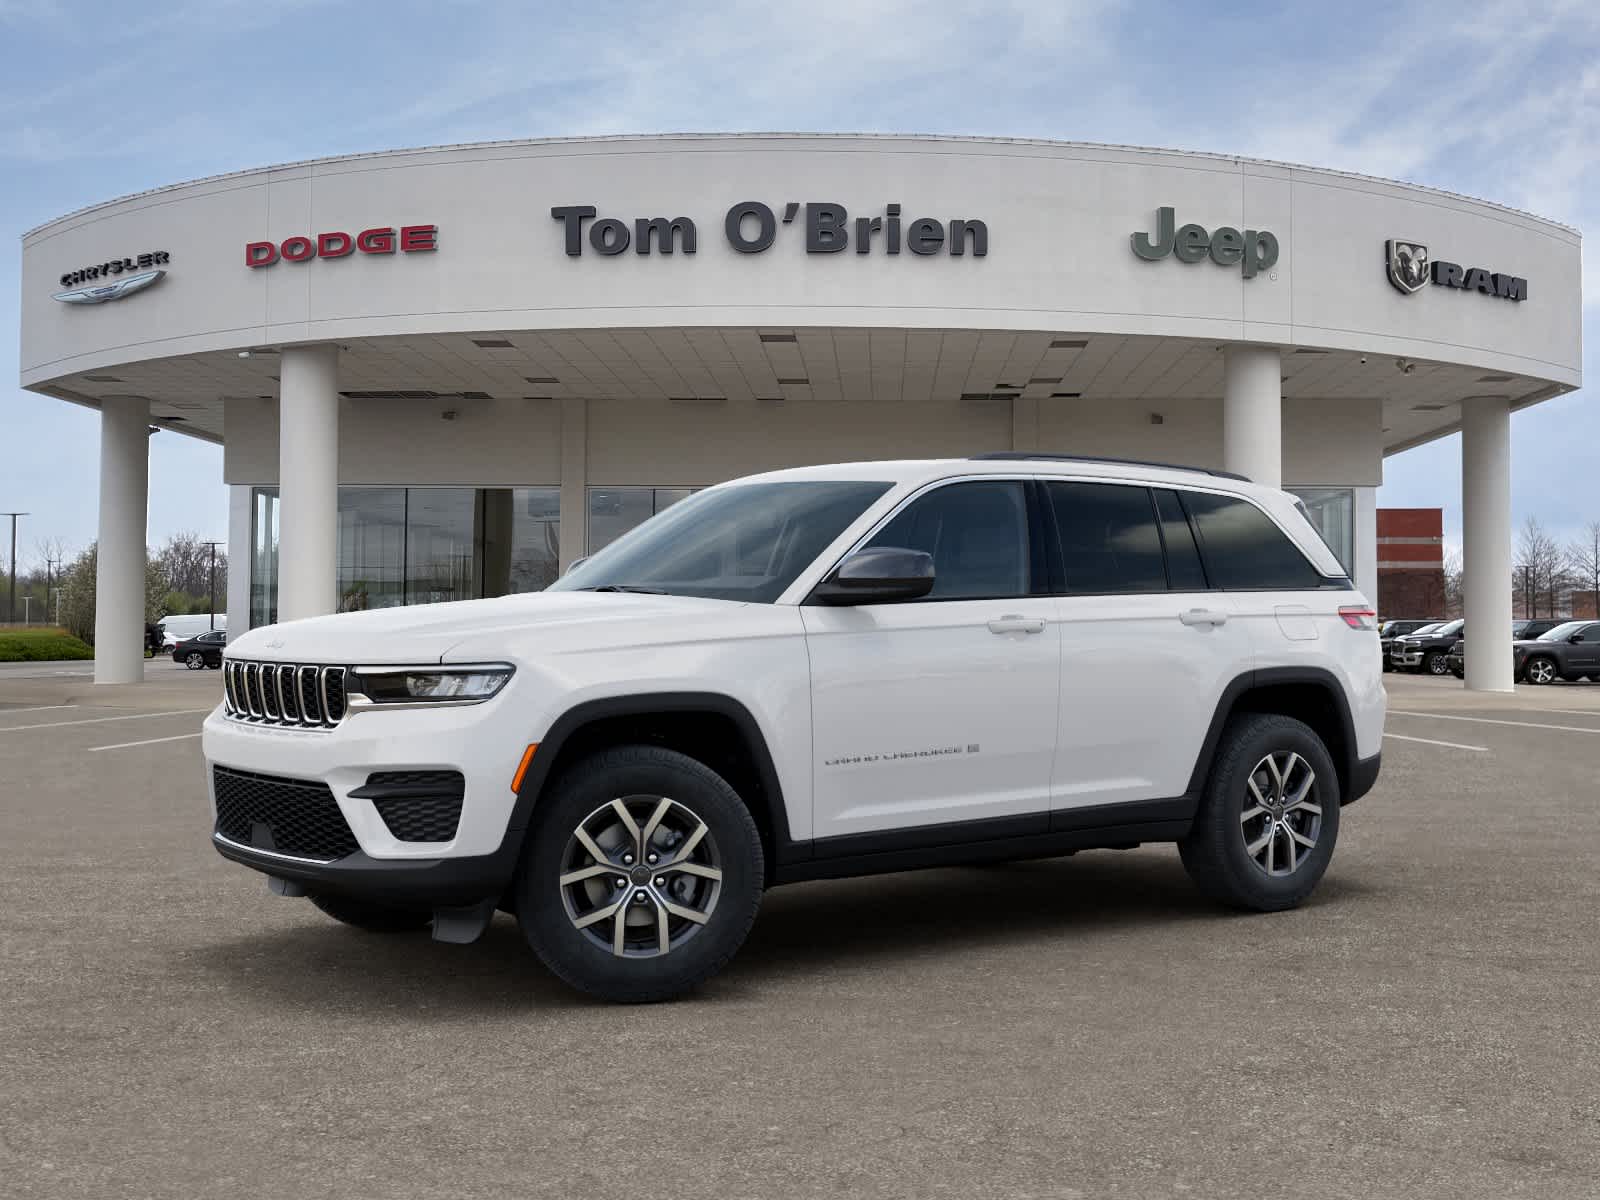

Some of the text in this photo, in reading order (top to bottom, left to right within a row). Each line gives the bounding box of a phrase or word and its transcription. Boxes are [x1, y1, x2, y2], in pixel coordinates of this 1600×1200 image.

[245, 224, 438, 268] DODGE
[551, 201, 988, 256] Tom O’Brien
[1131, 206, 1279, 279] Jeep
[61, 250, 171, 288] CHRYSLER
[1430, 261, 1527, 301] RAM
